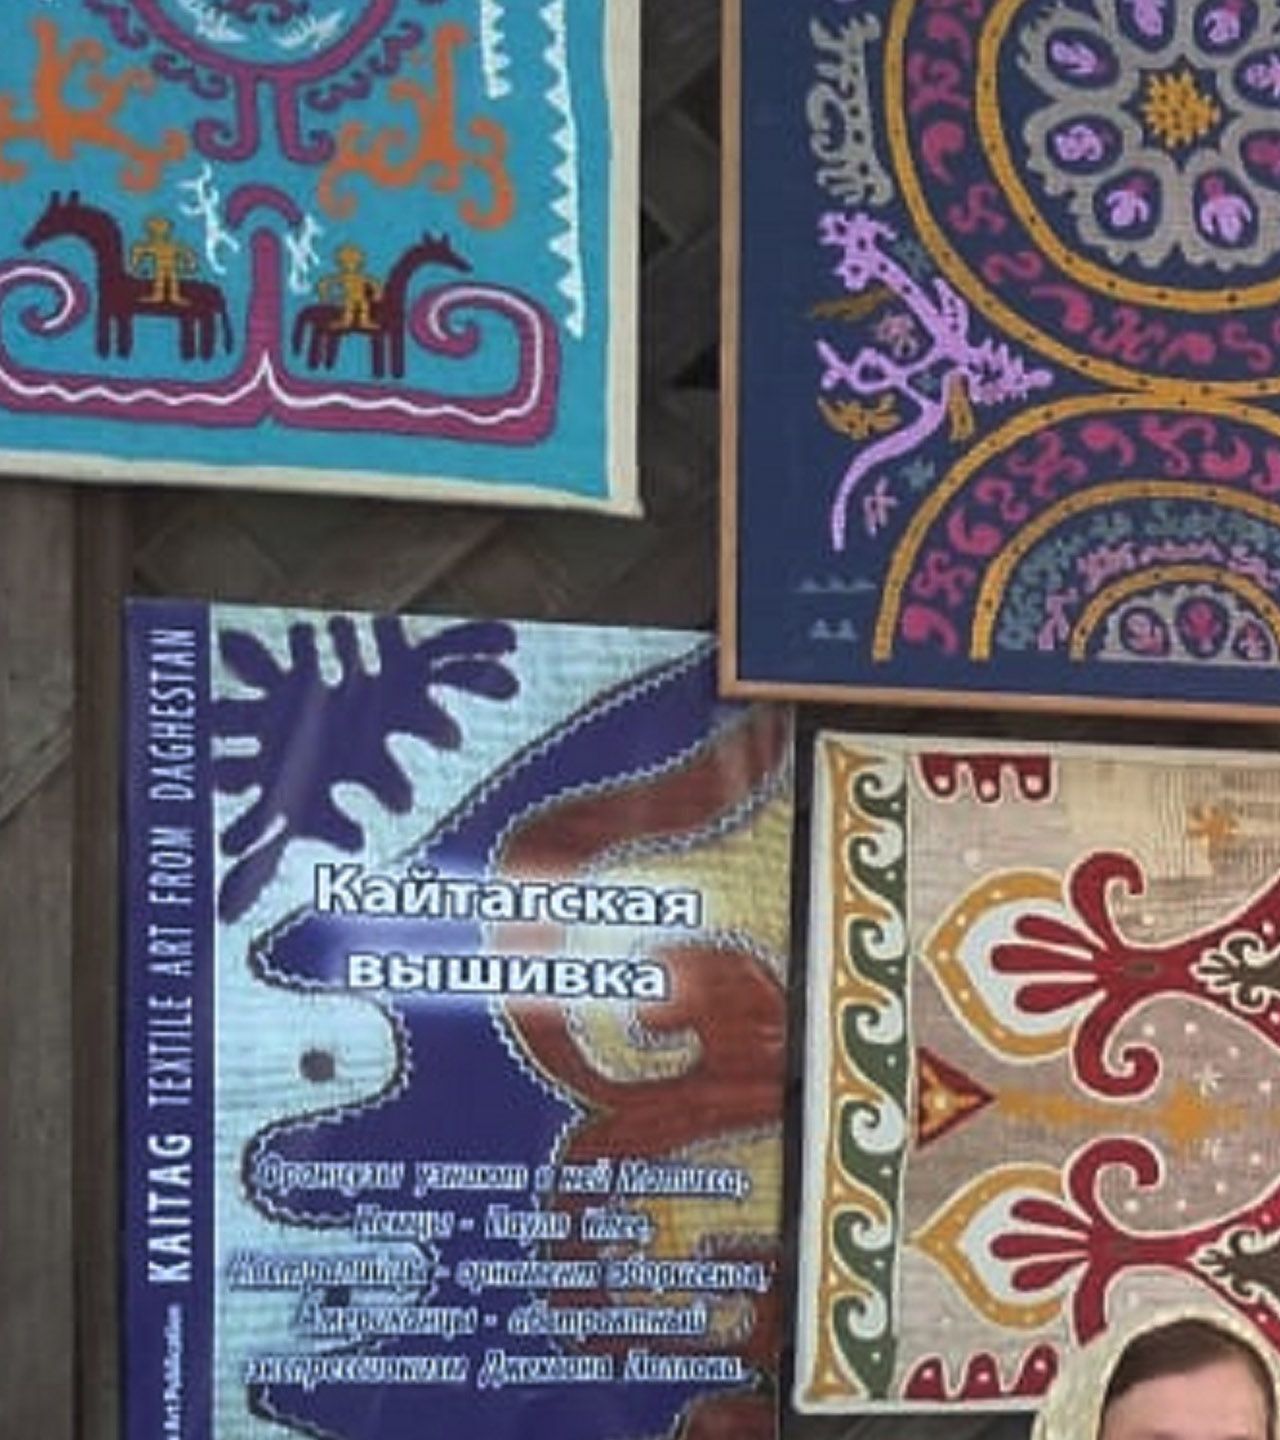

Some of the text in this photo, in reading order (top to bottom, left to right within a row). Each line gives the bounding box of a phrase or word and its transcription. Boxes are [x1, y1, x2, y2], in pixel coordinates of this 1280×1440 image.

[314, 863, 701, 925] Кайтагская
[147, 628, 196, 1282] KAITAG TEXTILE ART FROM DAGHESTAN
[348, 952, 668, 998] вышивка
